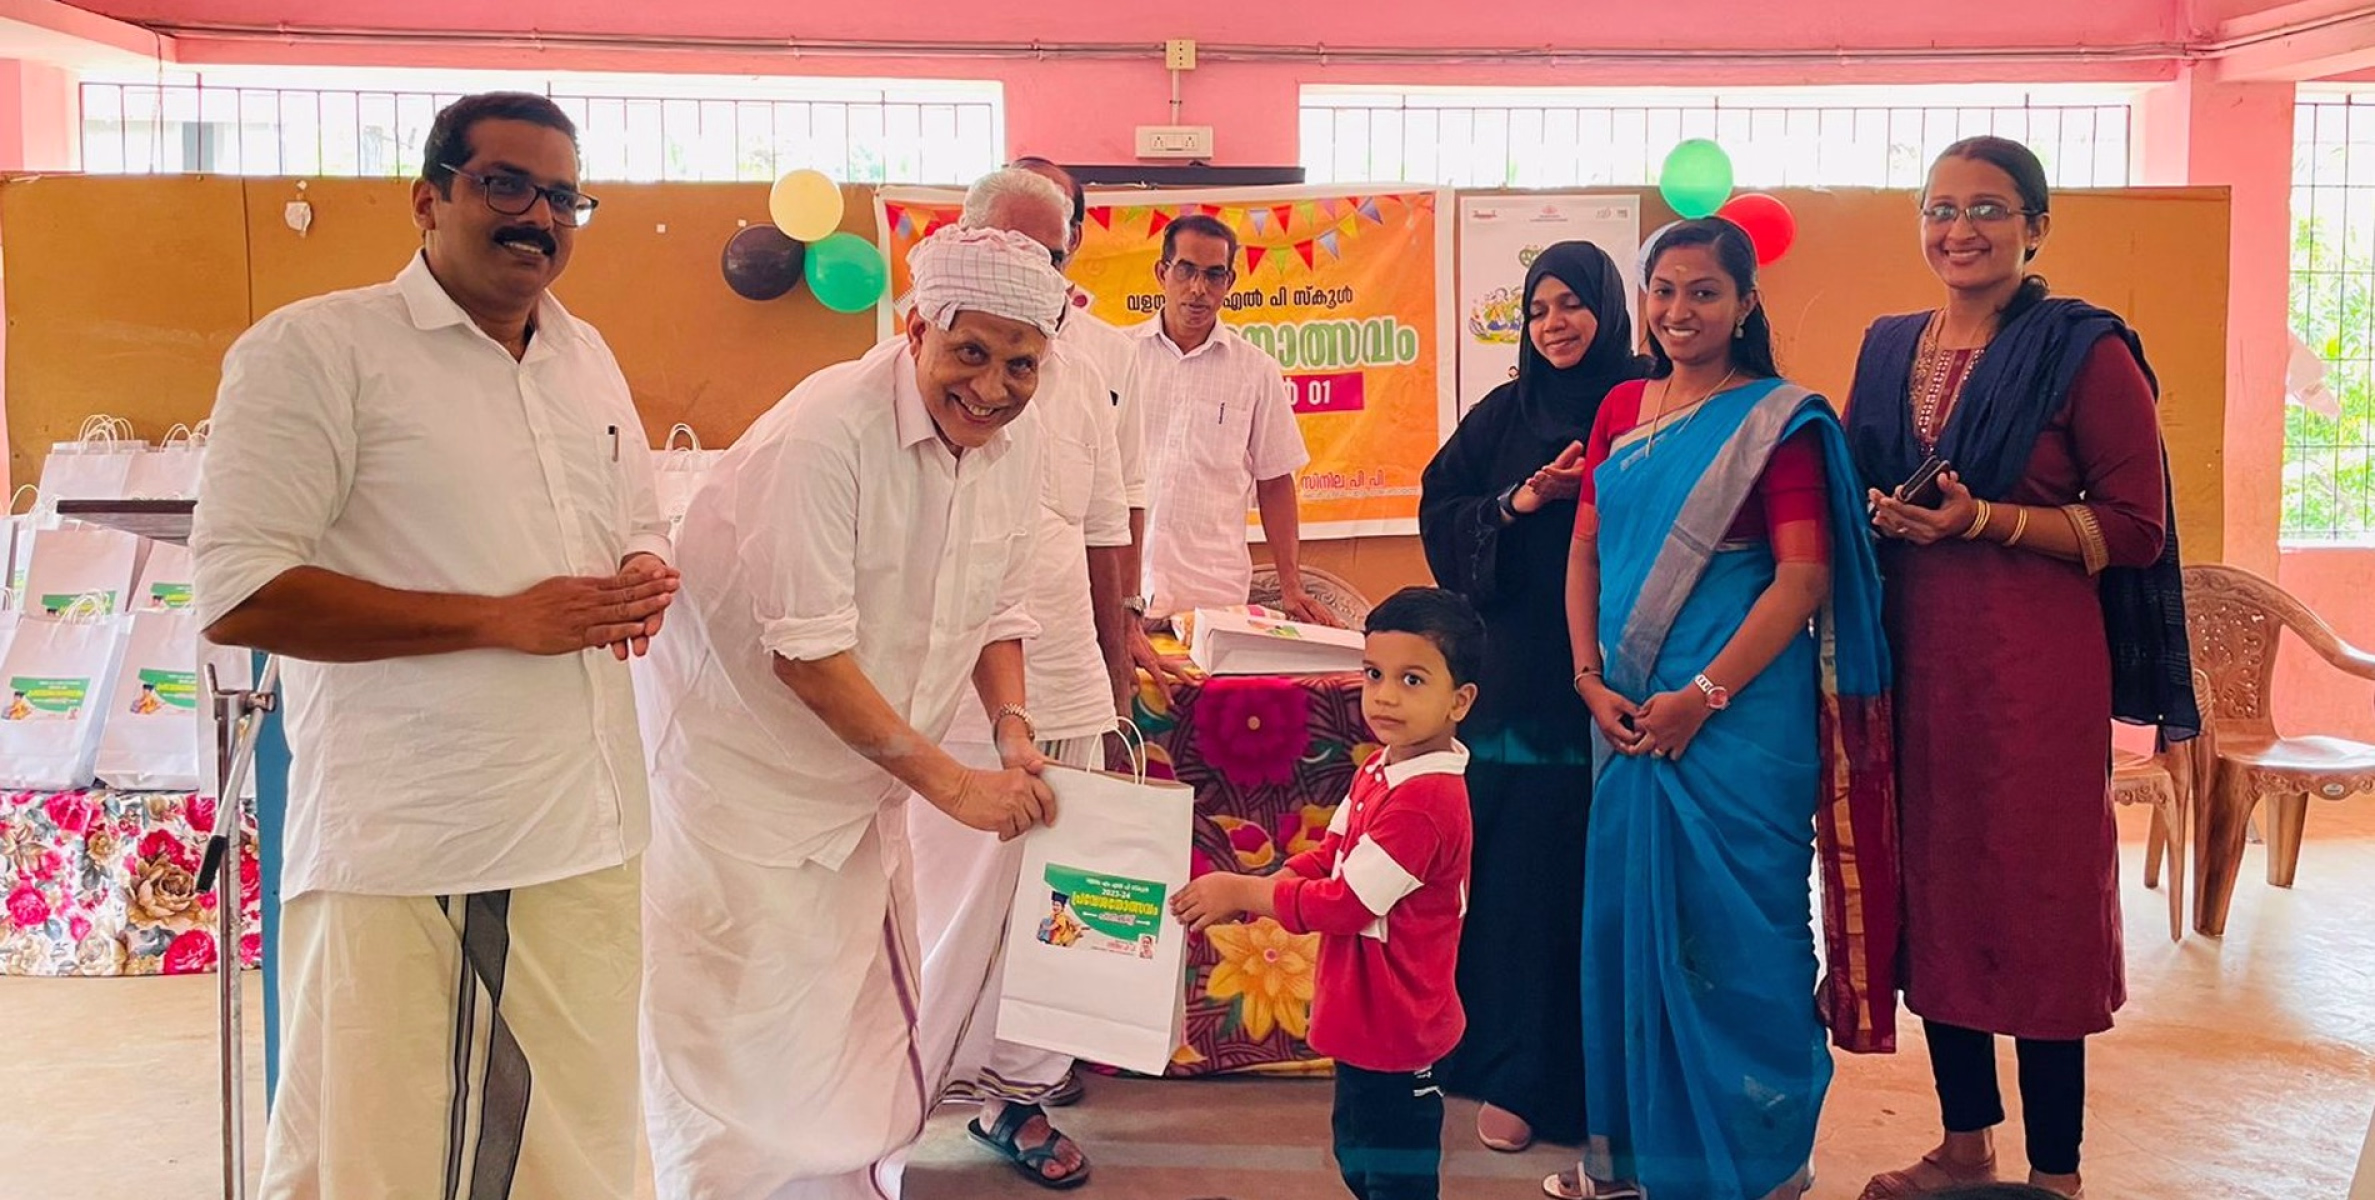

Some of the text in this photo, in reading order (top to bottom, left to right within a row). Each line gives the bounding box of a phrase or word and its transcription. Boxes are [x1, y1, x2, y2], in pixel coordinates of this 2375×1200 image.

[1269, 286, 1287, 306] പി
[1294, 285, 1353, 309] സ്കൂൾ
[1308, 378, 1332, 405] 01
